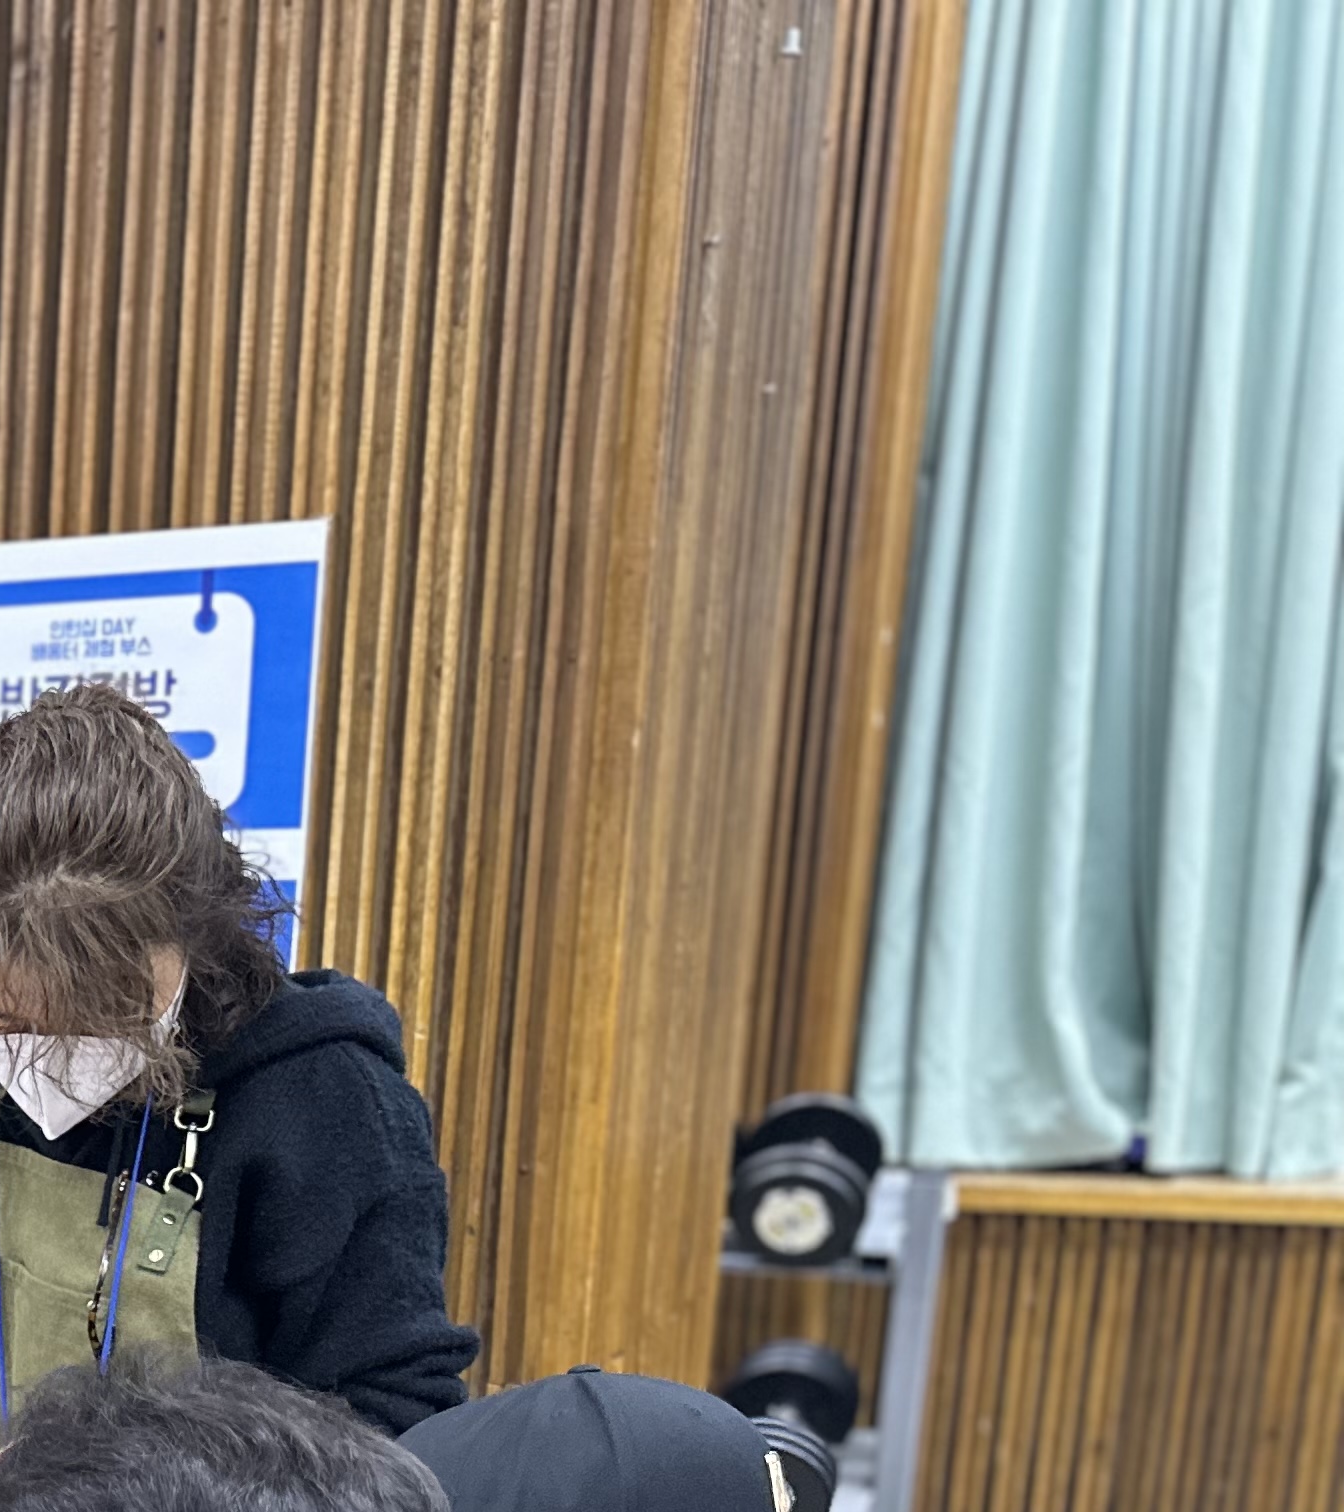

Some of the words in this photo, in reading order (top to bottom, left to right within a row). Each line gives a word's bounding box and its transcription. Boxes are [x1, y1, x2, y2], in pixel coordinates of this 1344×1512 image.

[50, 618, 97, 639] 인턴십
[102, 617, 135, 636] DAY
[84, 638, 115, 658] 체험
[120, 636, 152, 656] 부스
